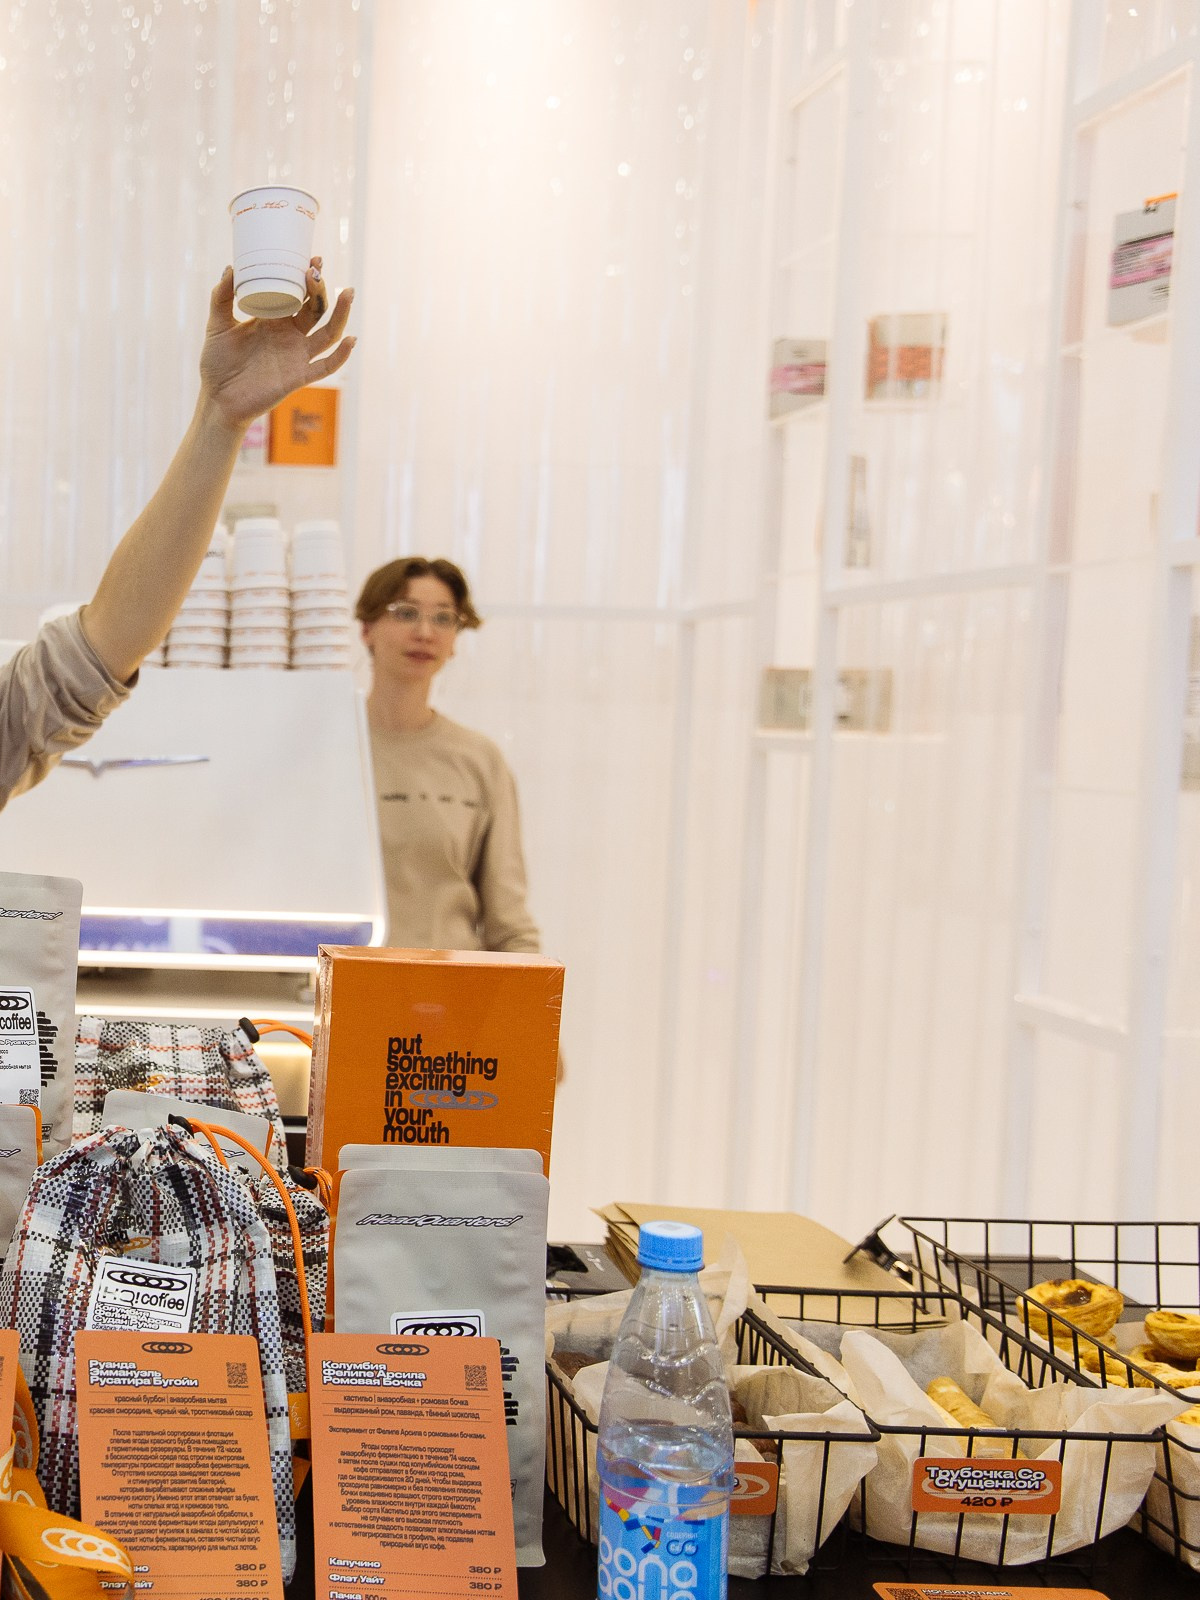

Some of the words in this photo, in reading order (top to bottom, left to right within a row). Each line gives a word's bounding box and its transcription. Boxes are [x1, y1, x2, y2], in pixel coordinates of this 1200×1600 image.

[388, 1034, 422, 1055] put
[387, 1051, 498, 1080] something
[386, 1071, 466, 1096] exciting
[385, 1089, 402, 1107] in
[384, 1108, 433, 1126] your
[383, 1121, 449, 1143] mouth
[89, 1359, 136, 1370] Руанда
[322, 1360, 387, 1371] Колумбия
[89, 1368, 162, 1378] Эммануэль
[322, 1368, 376, 1378] Фелипе
[377, 1370, 426, 1381] Арсила
[89, 1376, 151, 1387] Русатира
[152, 1377, 198, 1388] Бугойи
[322, 1376, 382, 1386] Ромовая
[382, 1377, 423, 1388] Бочка
[114, 1395, 142, 1403] красный
[142, 1394, 166, 1403] бурбон
[169, 1396, 207, 1404] анаэробная
[377, 1397, 416, 1405] анаэробная
[420, 1398, 449, 1406] ромовая
[450, 1398, 469, 1406] бочка
[333, 1407, 380, 1415] выдержанный
[381, 1409, 395, 1417] ром,
[425, 1410, 450, 1418] тёмный
[451, 1411, 480, 1420] шоколад
[328, 1425, 368, 1435] Эксперимент
[376, 1428, 400, 1436] Фелипе
[400, 1428, 422, 1436] Арсила
[926, 1466, 1014, 1481] Трубочка
[1017, 1468, 1046, 1481] Со
[934, 1476, 1041, 1491] Сгущенкой
[961, 1496, 997, 1507] 420
[328, 1557, 381, 1568] Капучино
[469, 1565, 492, 1574] 380
[328, 1573, 358, 1584] Флэт
[359, 1575, 385, 1585] Уайт
[469, 1582, 492, 1590] 380
[329, 1591, 362, 1600] Пачка
